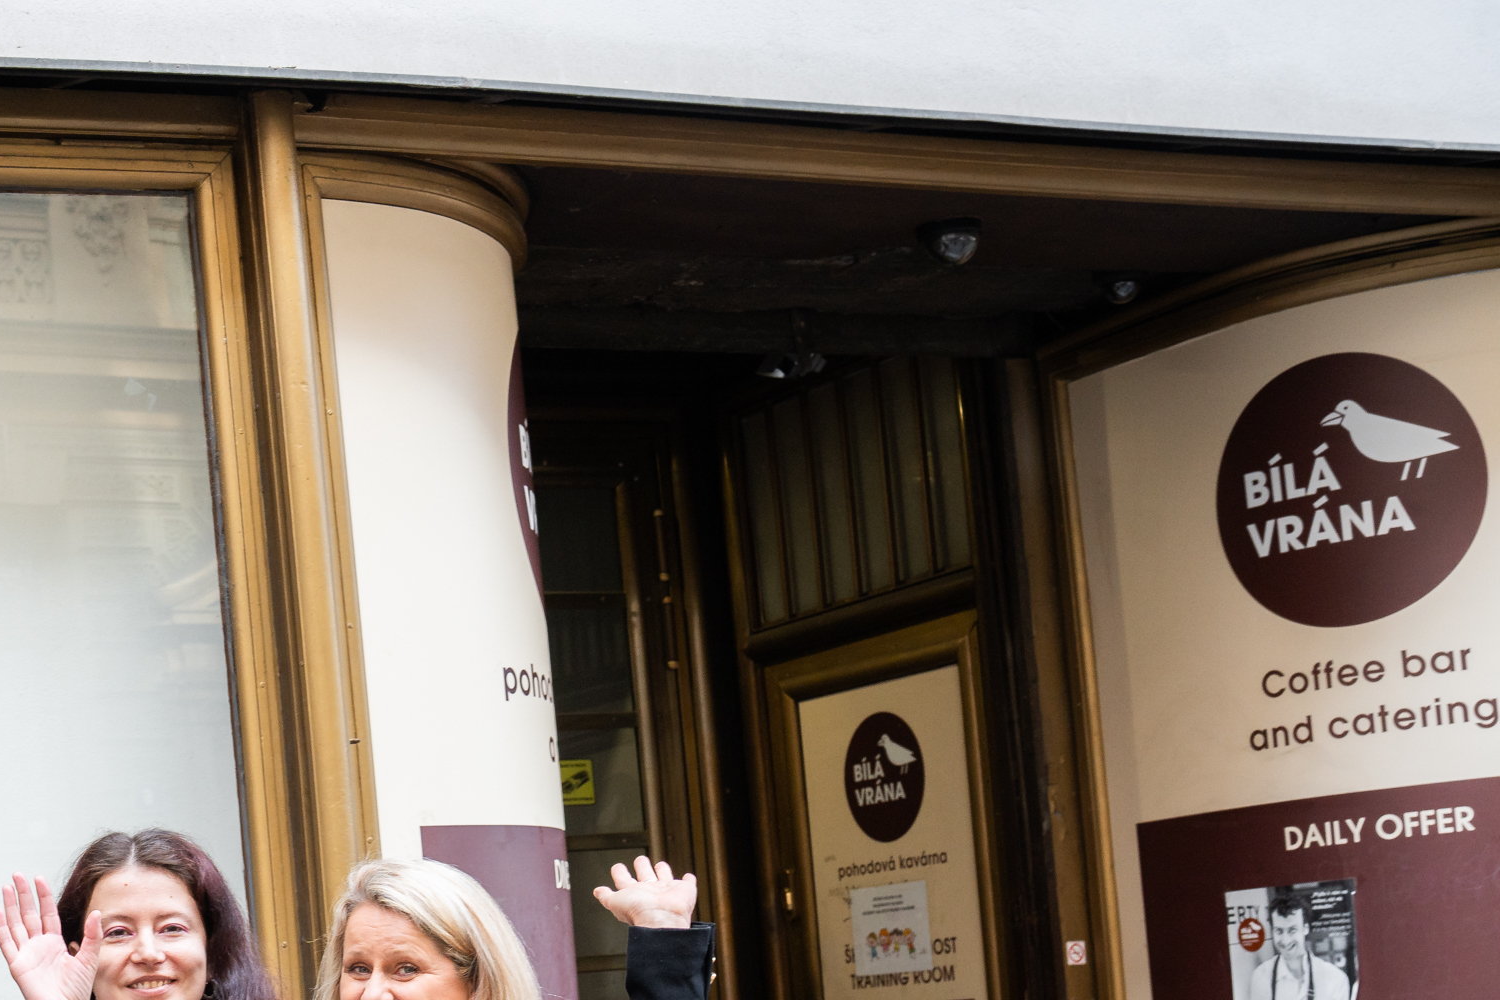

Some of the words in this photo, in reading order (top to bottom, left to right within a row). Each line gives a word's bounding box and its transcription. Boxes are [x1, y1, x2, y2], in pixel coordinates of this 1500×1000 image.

[1243, 442, 1342, 509] BÍLÁ
[1246, 495, 1416, 558] VRÁNA
[1262, 658, 1385, 698] Coffee
[1402, 647, 1471, 678] bar
[1249, 716, 1314, 751] and
[1328, 696, 1499, 739] catering
[853, 754, 885, 783] BÍLÁ
[855, 781, 906, 808] VRÁNA
[1284, 817, 1365, 851] DAILY
[1375, 805, 1476, 840] OFFER
[838, 856, 896, 881] pohodová
[899, 851, 948, 869] kavárna
[850, 972, 909, 990] TRAINING
[913, 965, 955, 984] ROOM
